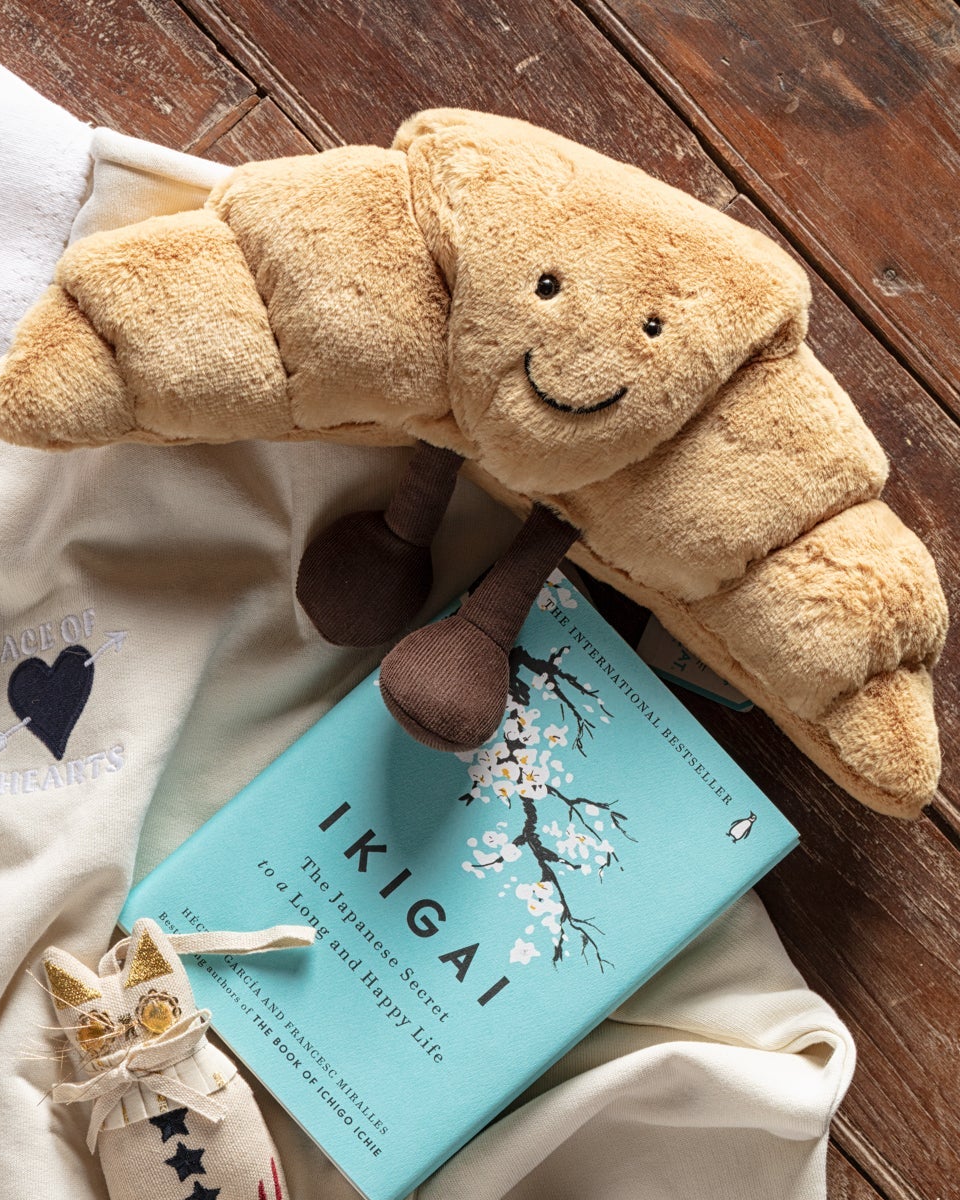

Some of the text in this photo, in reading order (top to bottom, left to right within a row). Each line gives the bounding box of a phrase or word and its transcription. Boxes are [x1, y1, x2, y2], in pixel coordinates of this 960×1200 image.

[0, 608, 95, 663] ACE OF
[544, 598, 733, 806] THE INTERNATIONAL BESTSELLER
[257, 859, 443, 1064] to a Long and Happy Life
[301, 856, 449, 1023] The Japanese Secret
[318, 801, 510, 1007] IKIGAI
[207, 966, 240, 1003] authors
[240, 1004, 254, 1016] of
[252, 1014, 274, 1037] THE
[272, 1037, 303, 1069] BOOK
[302, 1070, 319, 1086] OF
[317, 1086, 354, 1126] ICHIGO
[353, 1126, 383, 1158] ICHIE
[224, 954, 262, 997] GARCÍA
[261, 997, 285, 1021] AND
[284, 1020, 338, 1079] FRANCESC
[336, 1078, 389, 1135] MIRALLES
